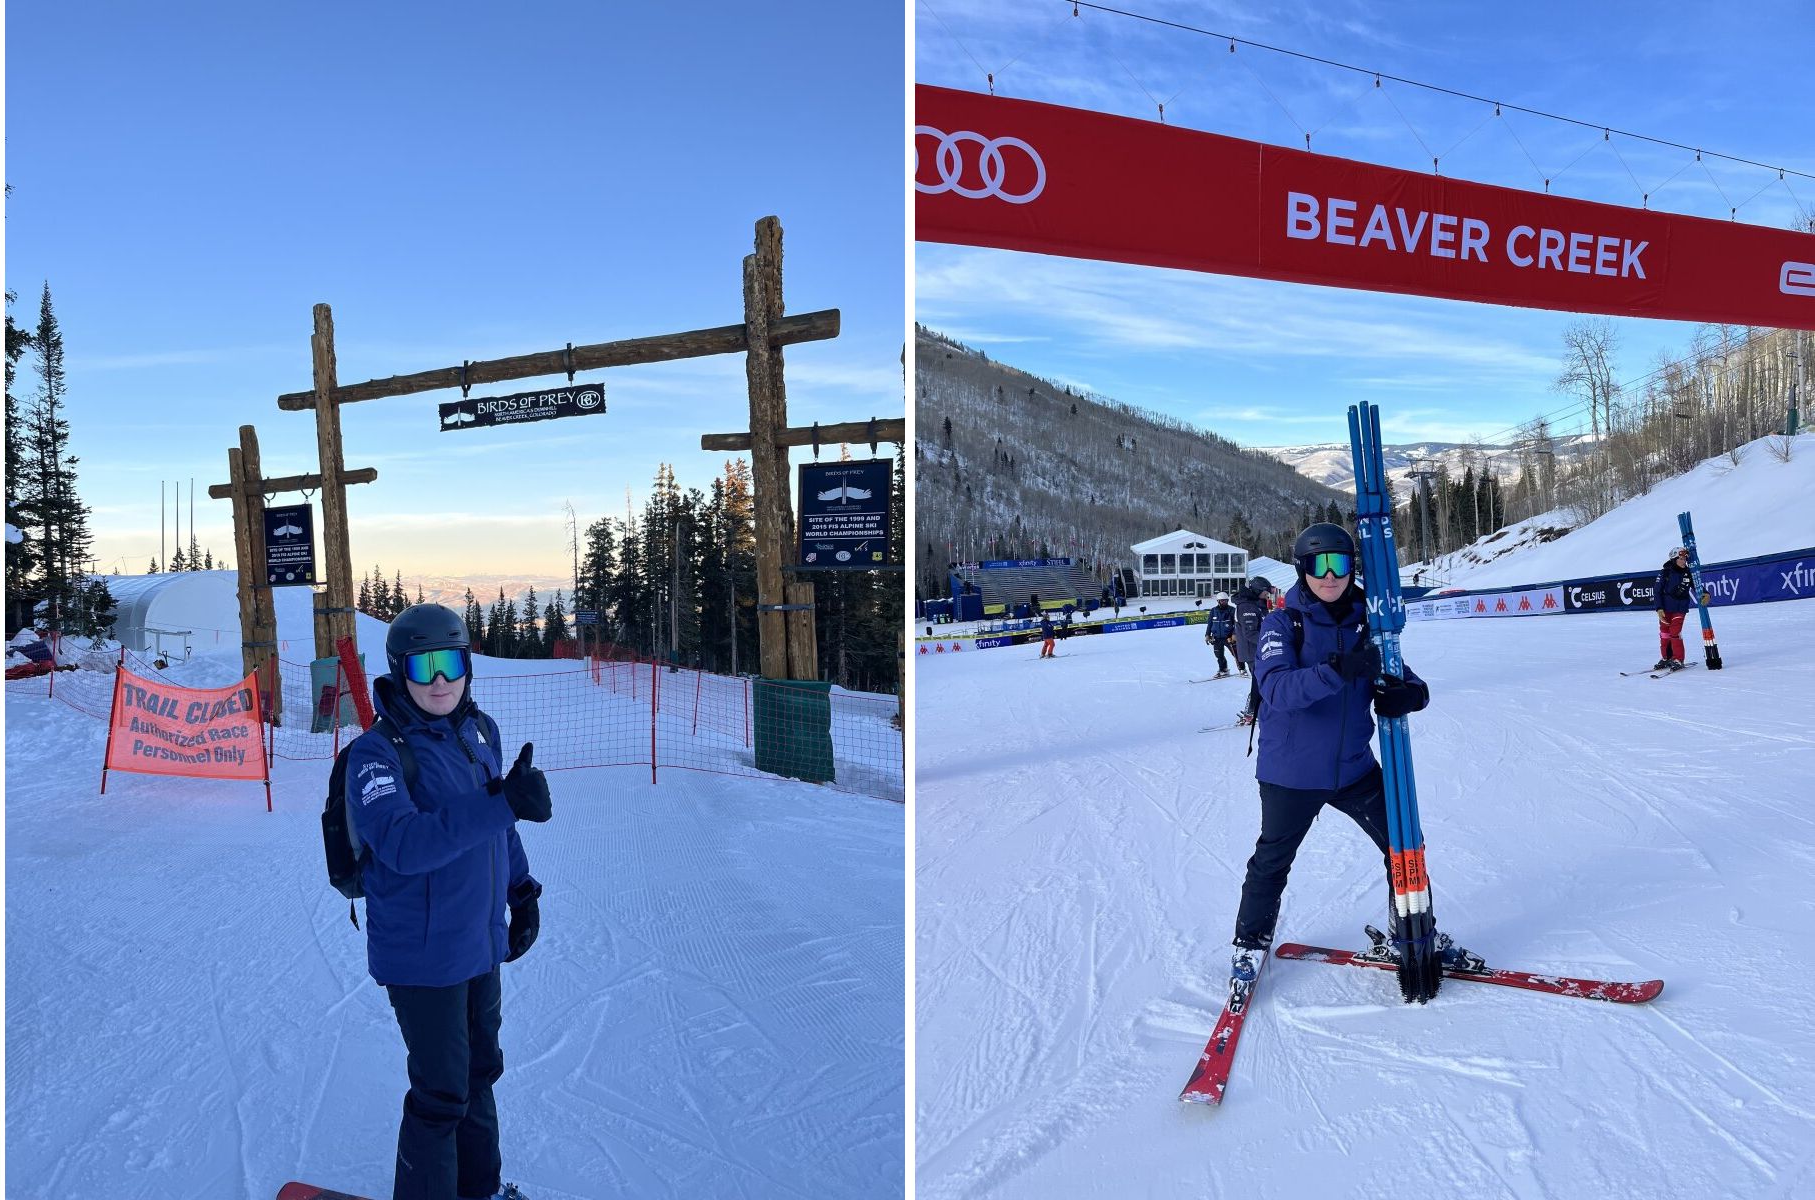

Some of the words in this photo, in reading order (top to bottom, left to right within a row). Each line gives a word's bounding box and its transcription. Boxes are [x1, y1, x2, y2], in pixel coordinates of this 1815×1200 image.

[1287, 191, 1491, 263] BEAVER
[1506, 225, 1650, 280] CREEK
[477, 400, 516, 414] BIRDS
[520, 397, 536, 408] OF
[540, 392, 576, 405] PREY
[1581, 591, 1605, 601] CELSIUS
[1632, 588, 1654, 597] CELSI
[123, 683, 178, 720] TRAIL
[185, 688, 254, 724] CLOSED
[130, 717, 206, 748] Authorized
[208, 724, 248, 742] Race
[133, 740, 211, 764] Personnel
[214, 746, 245, 766] Only
